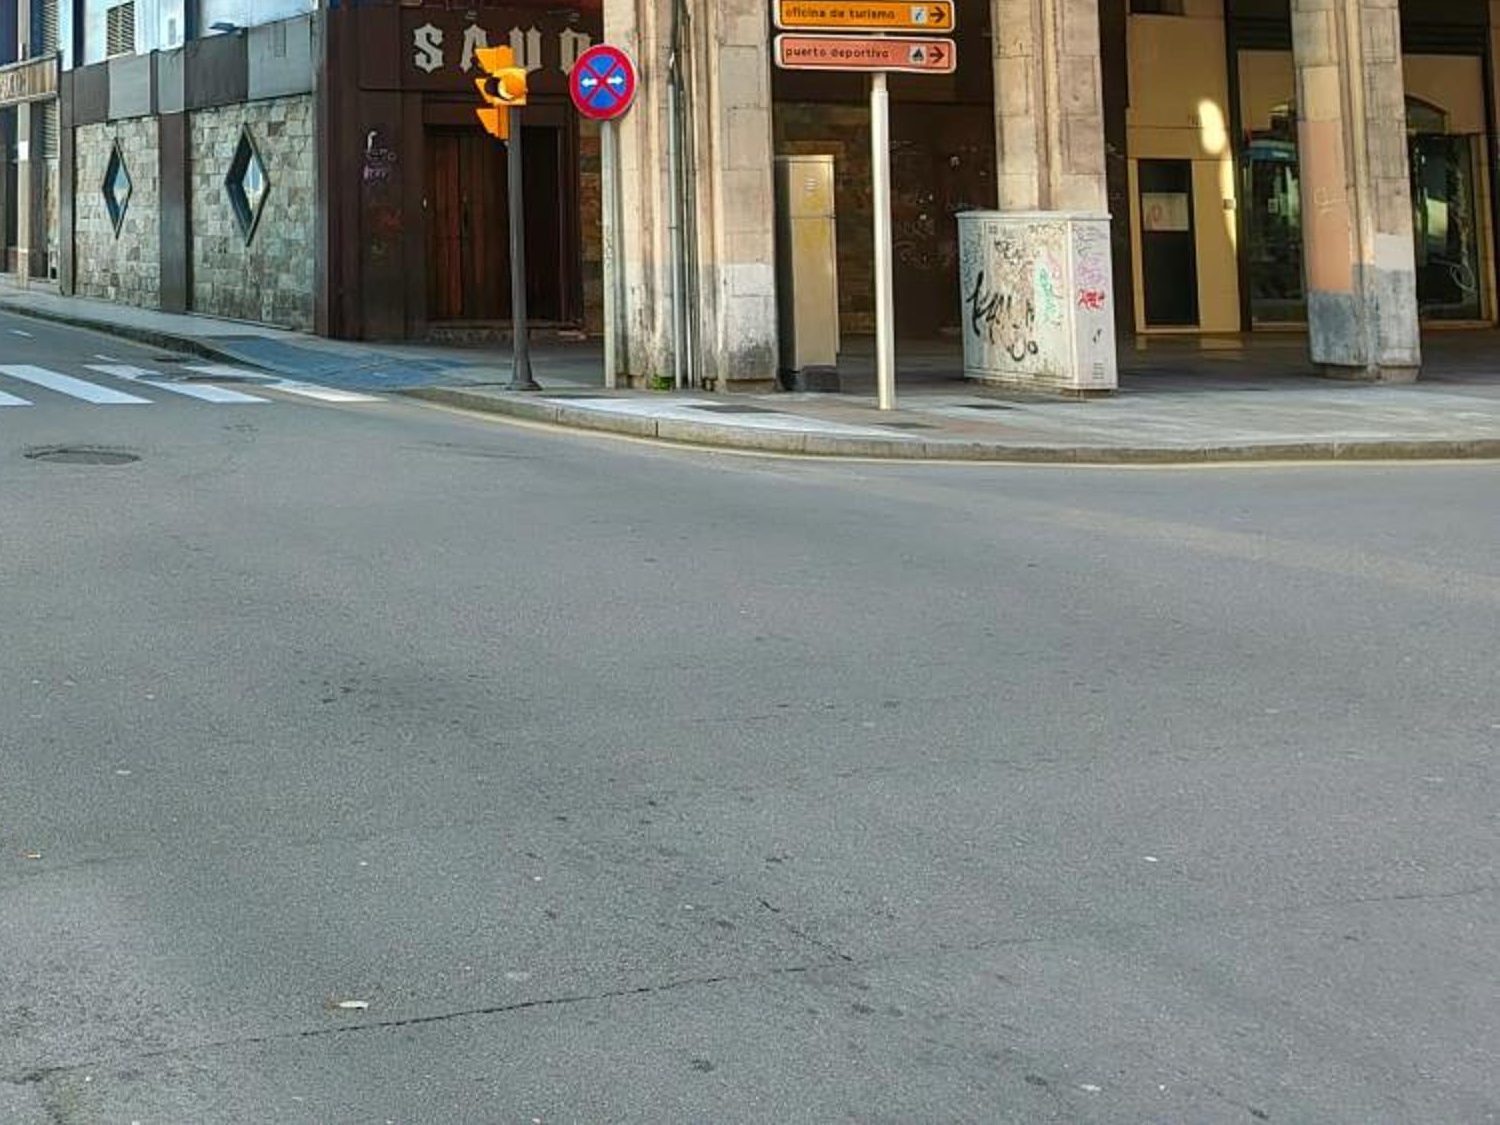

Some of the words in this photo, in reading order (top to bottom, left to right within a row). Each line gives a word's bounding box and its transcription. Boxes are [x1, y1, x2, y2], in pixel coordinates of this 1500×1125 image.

[786, 7, 826, 18] oficina
[829, 7, 845, 18] de
[850, 8, 896, 20] turismo
[786, 47, 827, 59] puerto
[830, 48, 889, 60] deportivo
